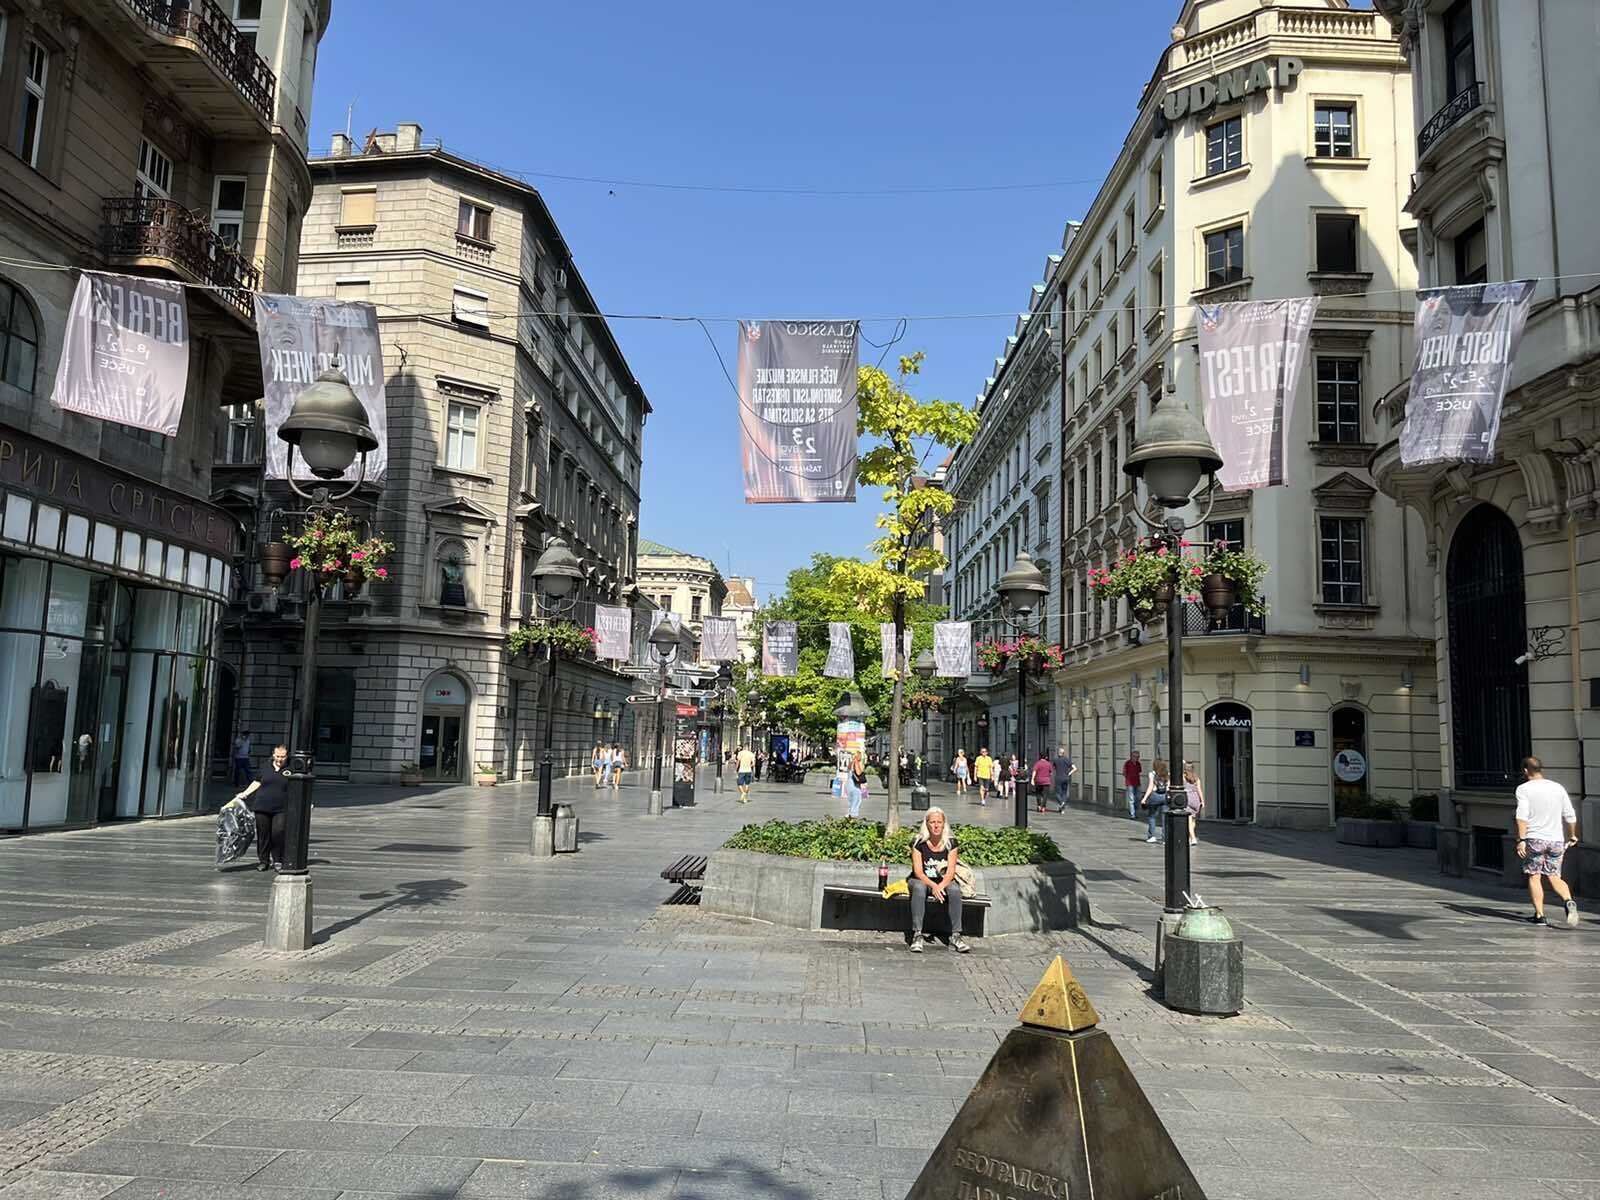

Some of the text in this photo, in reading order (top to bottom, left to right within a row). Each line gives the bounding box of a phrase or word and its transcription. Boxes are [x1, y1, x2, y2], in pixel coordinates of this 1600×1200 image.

[1153, 57, 1304, 138] UDNAP
[109, 482, 216, 544] СРПСКЕ
[951, 1147, 1070, 1199] БЕОГРАДСКА
